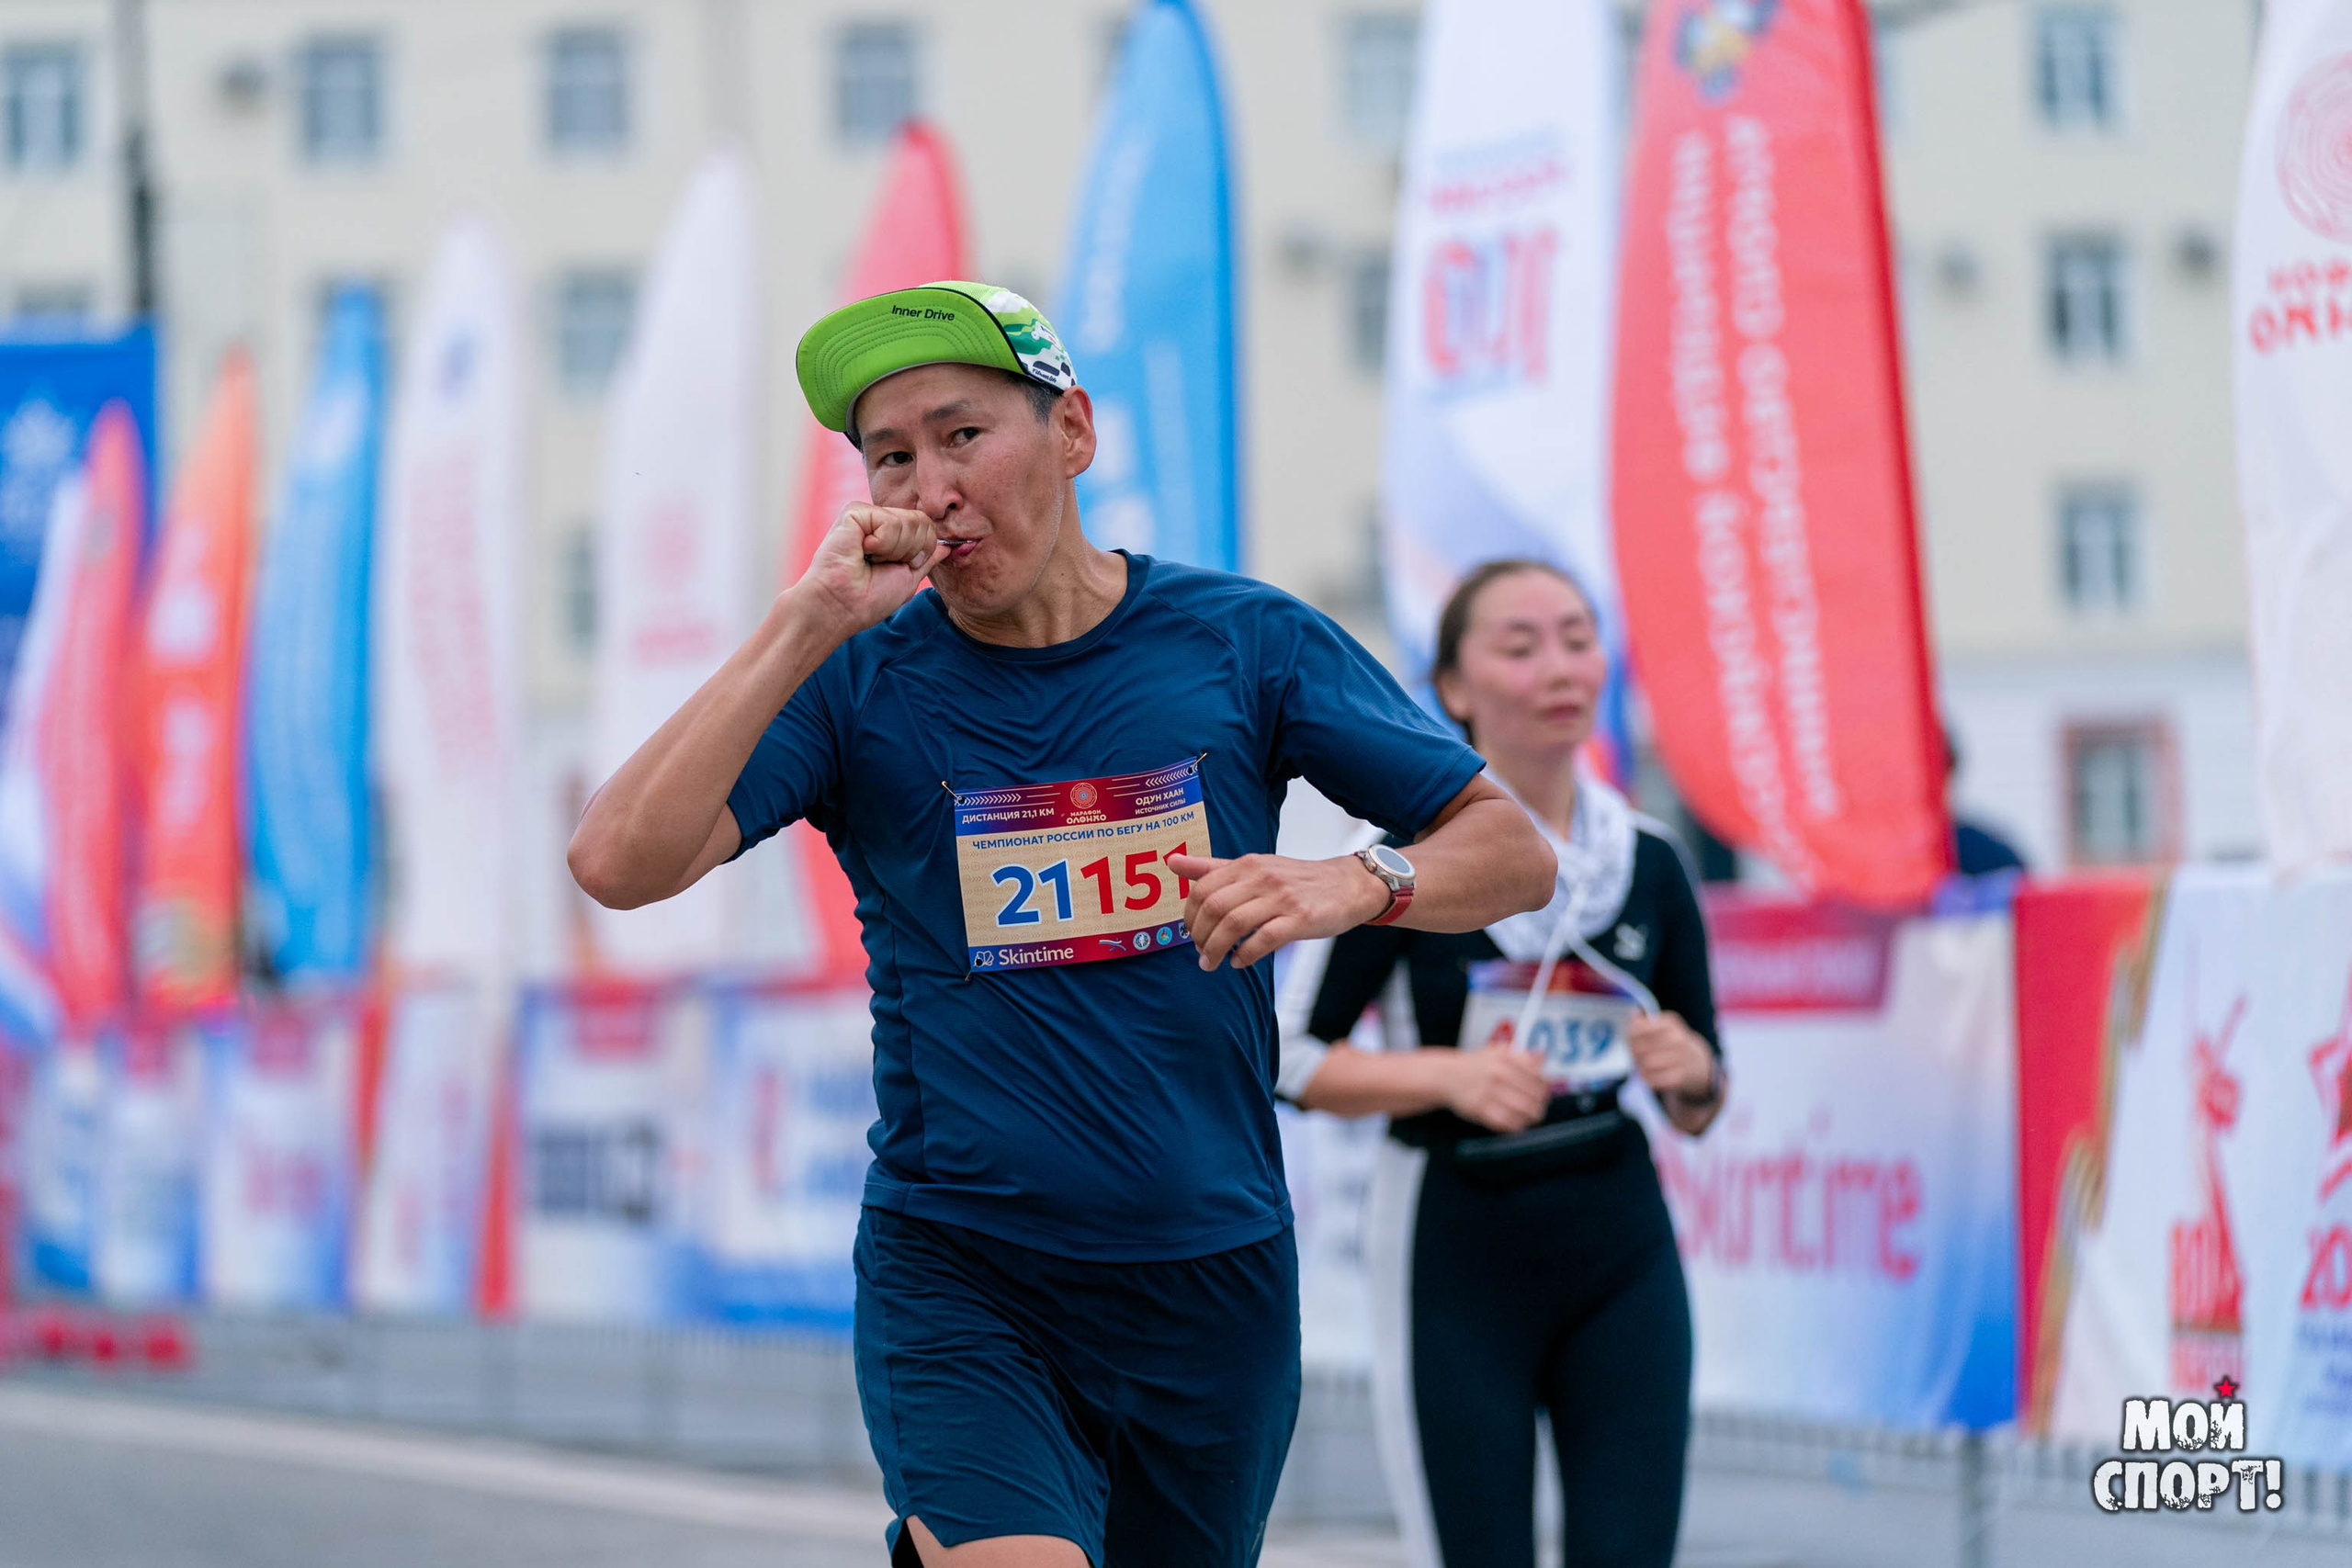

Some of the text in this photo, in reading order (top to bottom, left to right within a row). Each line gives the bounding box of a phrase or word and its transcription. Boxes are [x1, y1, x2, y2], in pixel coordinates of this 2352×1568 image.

[891, 305, 956, 321] Inner Drive
[1135, 787, 1184, 806] ОДУН ХААН
[1135, 798, 1186, 815] ИСТОЧНИК СИЛЫ
[962, 807, 1055, 824] ДИСТАНЦИЯ 21,1 КМ
[1066, 814, 1107, 825] ОЛОНХО
[972, 811, 1194, 850] ЧЕМПИОНАТ РОССИИ ПО БЕГУ НА 100 КМ
[999, 945, 1074, 965] Skintime
